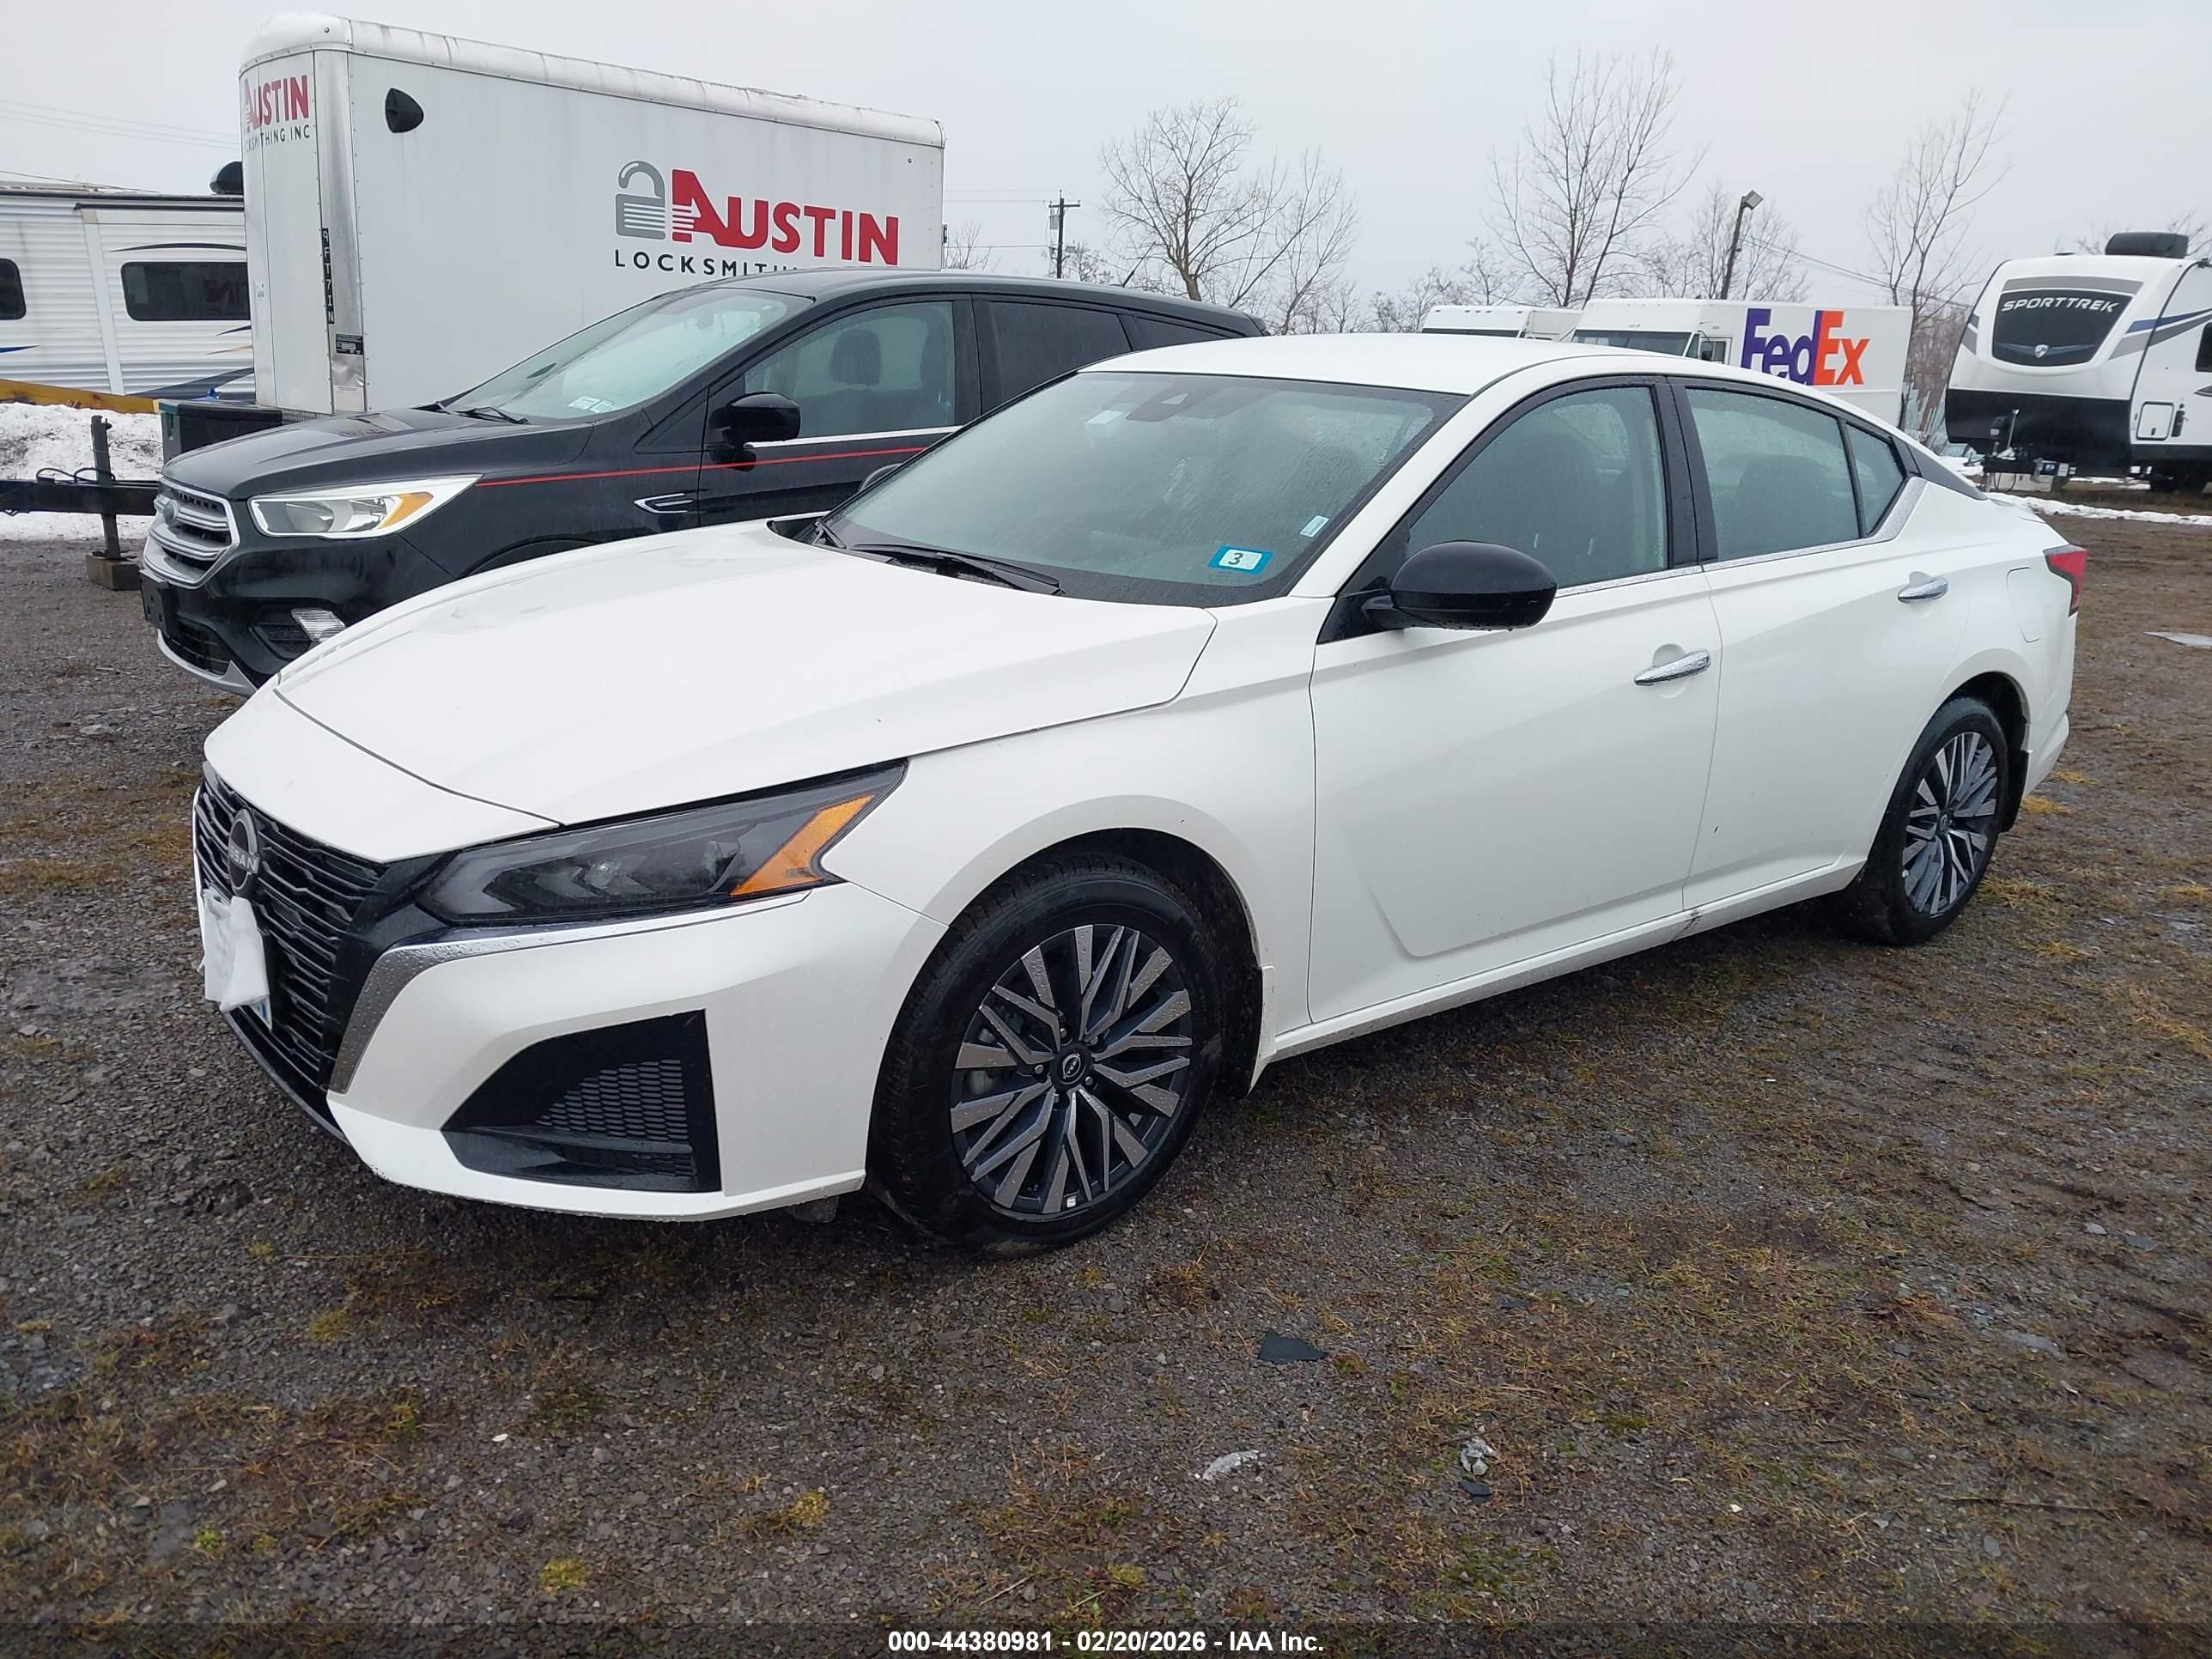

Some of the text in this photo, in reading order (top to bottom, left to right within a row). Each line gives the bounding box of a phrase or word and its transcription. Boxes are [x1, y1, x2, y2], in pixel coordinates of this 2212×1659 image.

[245, 75, 309, 133] AUSTIN
[289, 124, 310, 141] INC
[672, 168, 899, 266] AUSTIN
[2001, 297, 2119, 313] SPORTTREK
[1741, 307, 1870, 386] FedEx
[1228, 552, 1243, 566] 3
